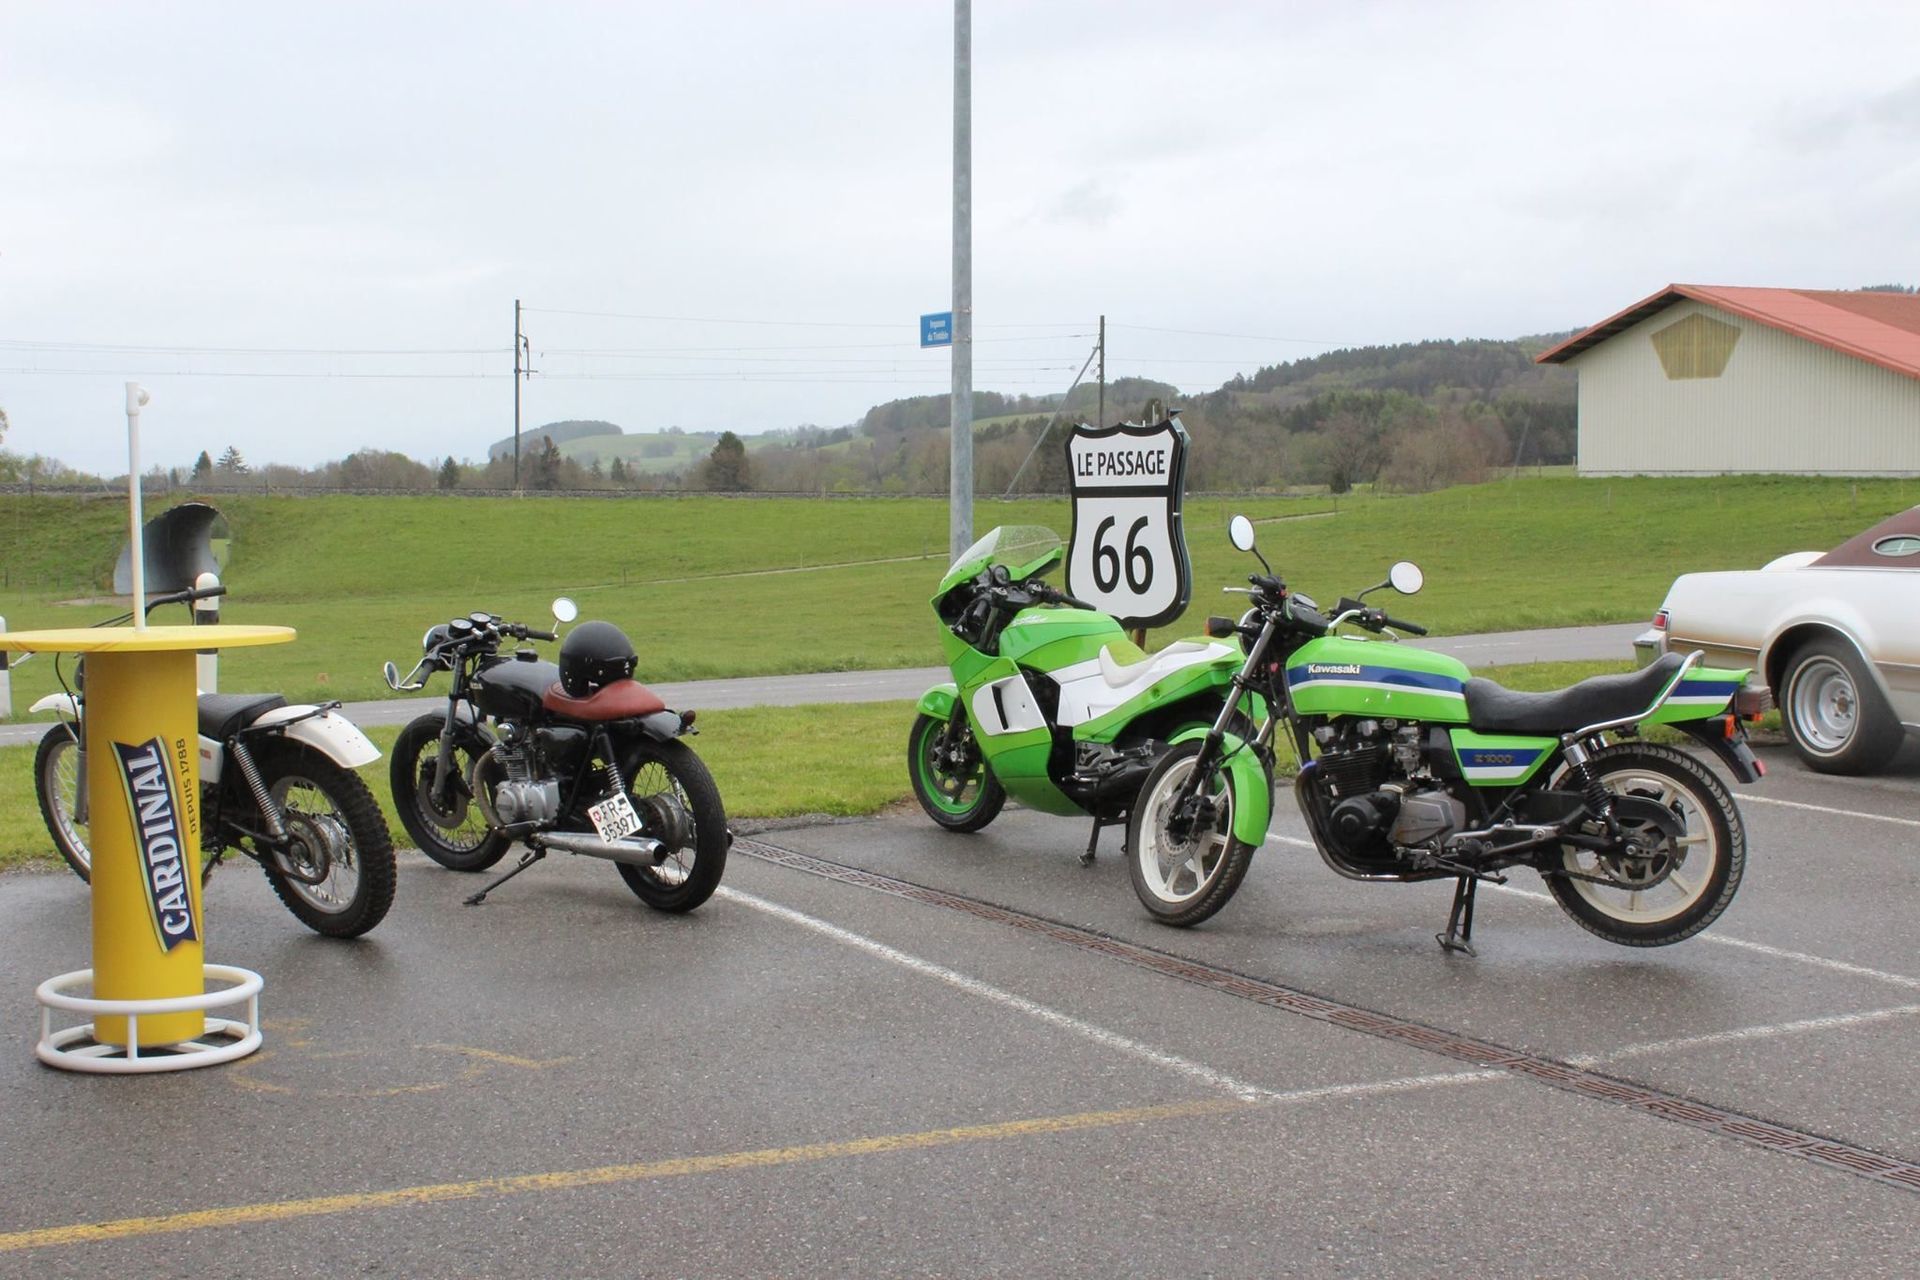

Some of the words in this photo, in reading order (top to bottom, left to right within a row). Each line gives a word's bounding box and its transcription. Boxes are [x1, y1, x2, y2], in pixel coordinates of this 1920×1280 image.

[1078, 453, 1093, 476] LE
[1098, 451, 1165, 476] PASSAGE
[1092, 516, 1153, 595] 66
[1308, 664, 1361, 674] Kawasaki
[176, 739, 190, 775] 1788
[182, 778, 196, 834] DEPUIS
[127, 746, 190, 935] CARDINAL
[602, 812, 637, 842] 35397
